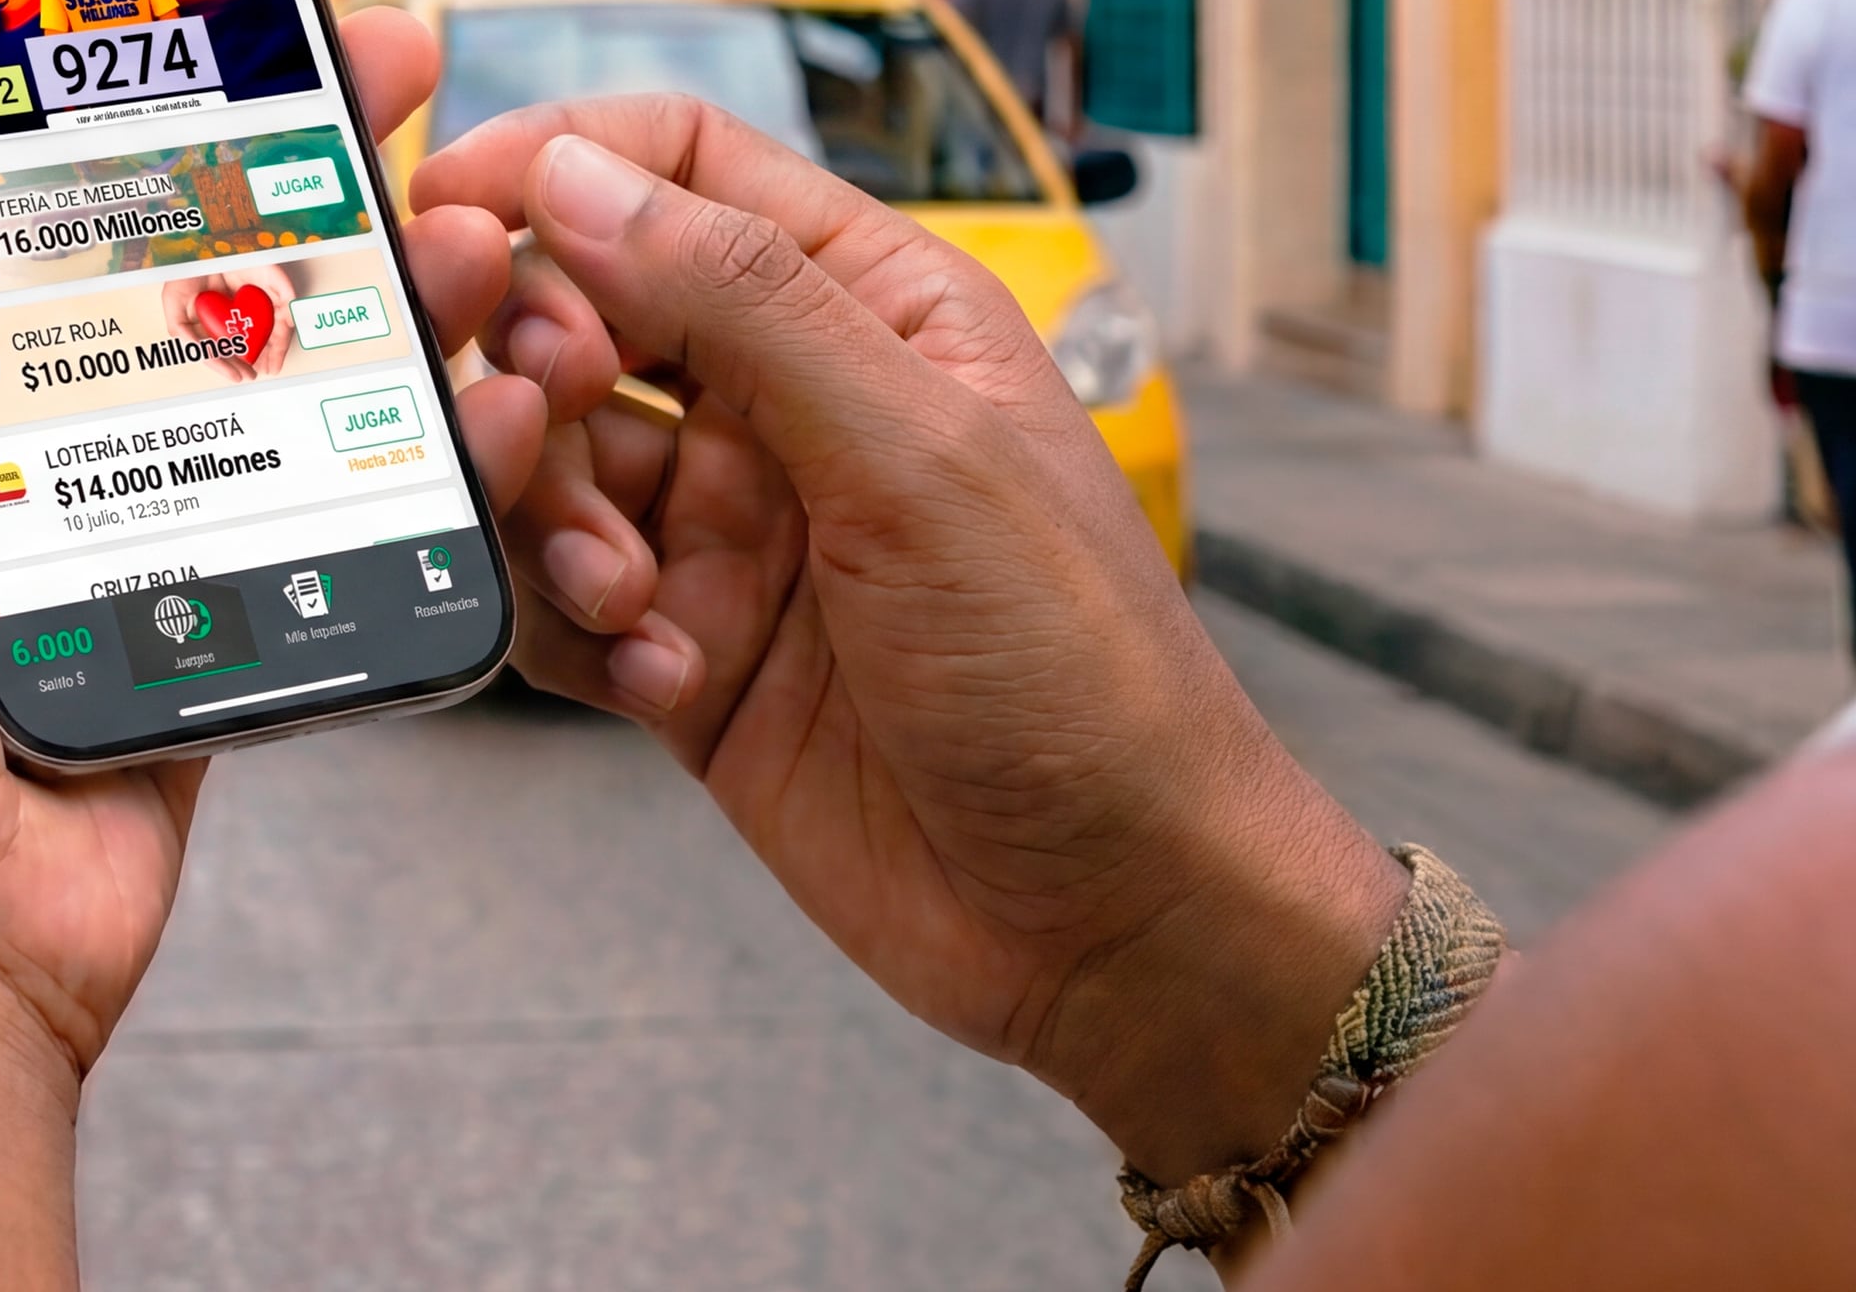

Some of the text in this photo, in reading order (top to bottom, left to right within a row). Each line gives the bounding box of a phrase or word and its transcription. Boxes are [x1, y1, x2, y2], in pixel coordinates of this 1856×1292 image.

[52, 28, 199, 96] 9274
[55, 189, 82, 208] DE
[270, 175, 325, 198] JUGAR
[93, 207, 203, 242] Millones
[11, 318, 124, 352] CRUZ ROJA
[313, 305, 370, 330] JUGAR
[20, 333, 248, 394] $10.000 Millones
[344, 406, 403, 433] JUGAR
[45, 412, 245, 470] LOTERÍA DE BOGOTÁ
[54, 446, 283, 509] $14.000 Millones
[63, 495, 201, 534] 10 julio, 12:33 pm
[90, 565, 200, 600] CRUZ ROJA
[10, 626, 94, 667] 6.000
